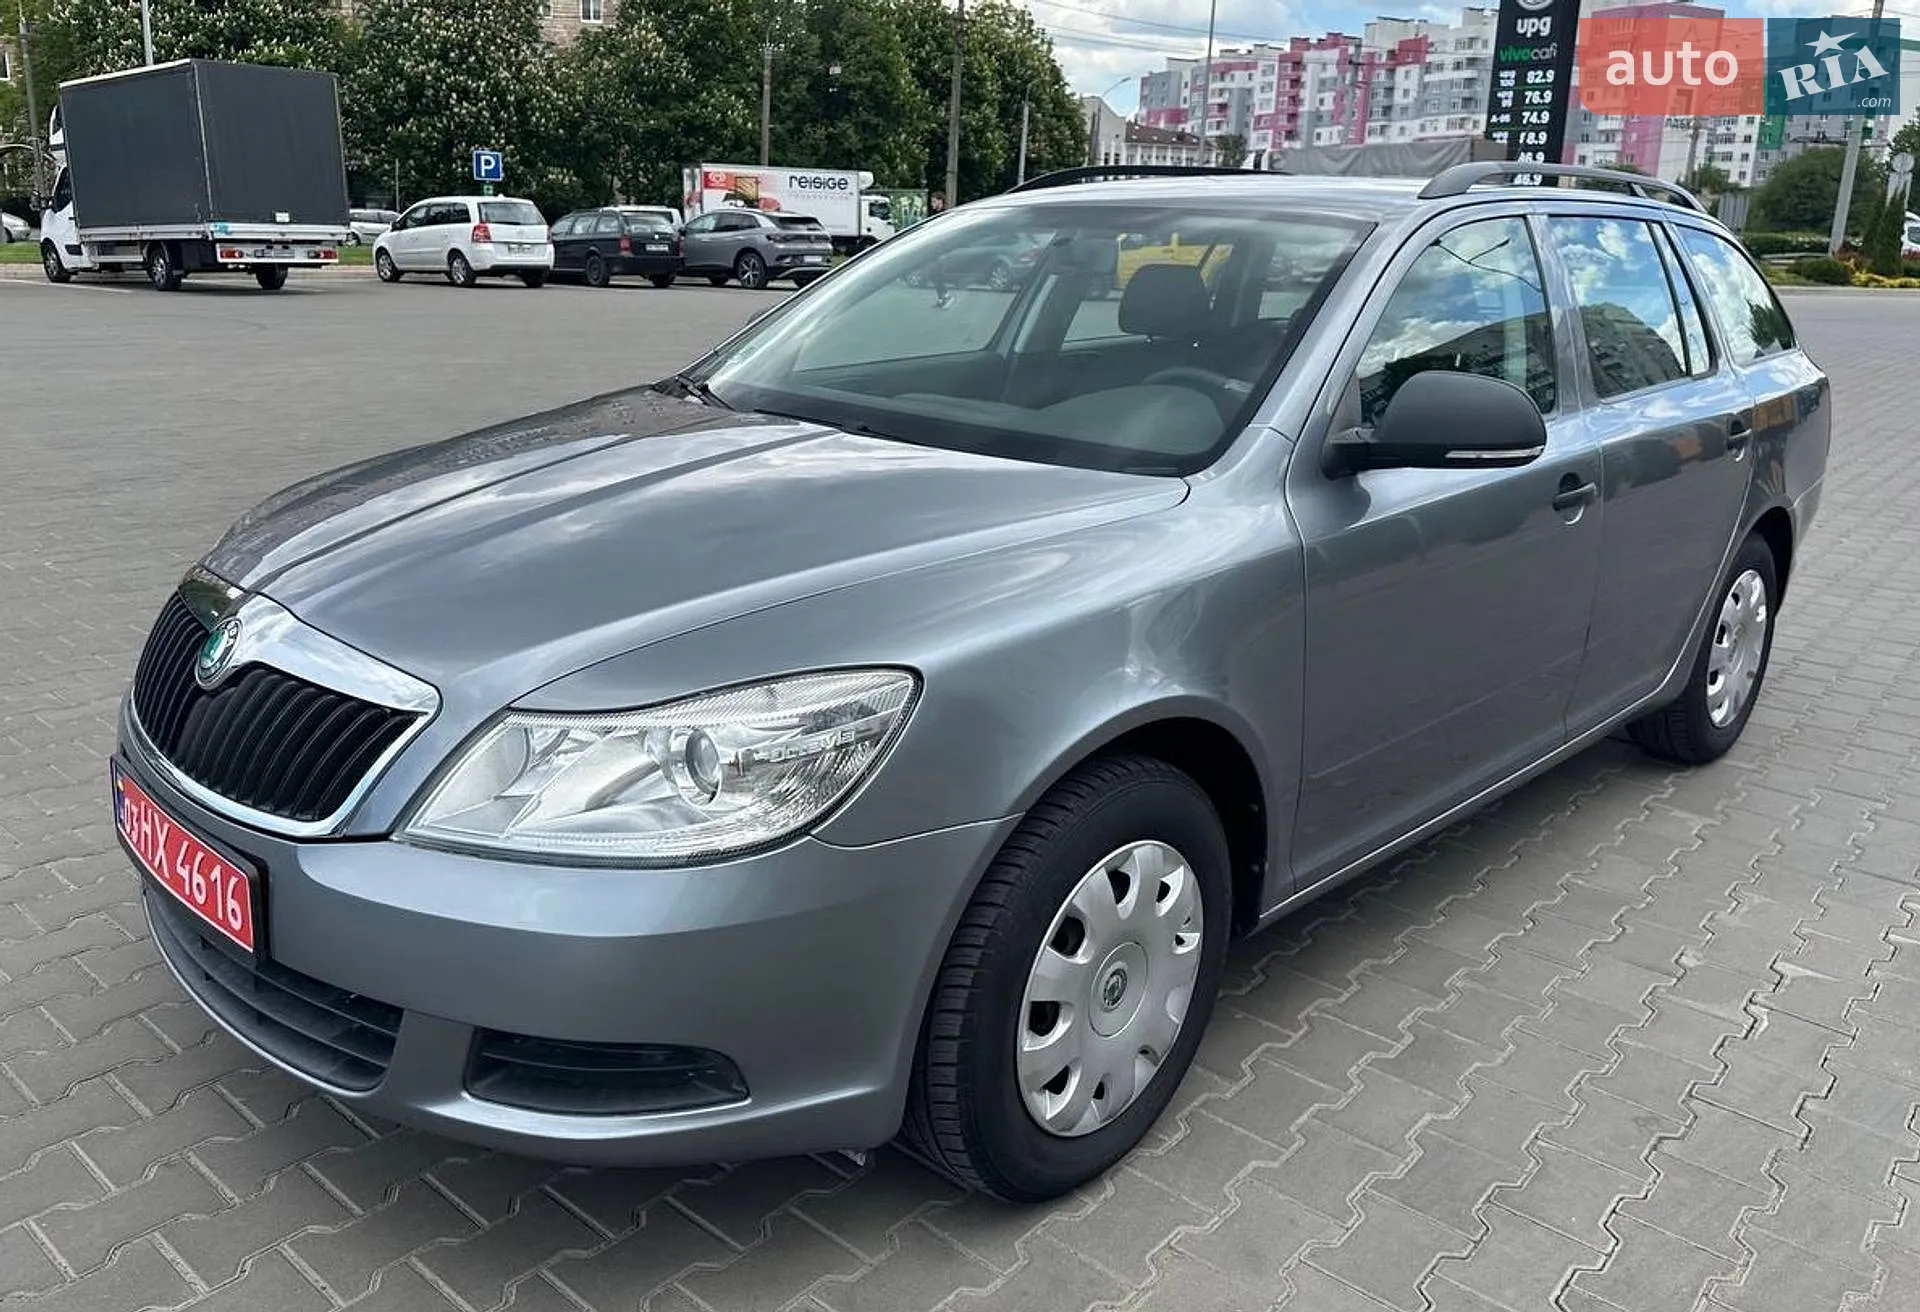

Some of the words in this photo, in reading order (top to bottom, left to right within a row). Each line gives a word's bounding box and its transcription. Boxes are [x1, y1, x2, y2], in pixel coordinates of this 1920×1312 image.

[1516, 16, 1553, 38] upg
[1526, 69, 1555, 84] 82.9
[1524, 90, 1553, 104] 76.9
[1521, 110, 1550, 124] 74.9
[480, 155, 496, 177] P
[176, 840, 243, 932] 4616
